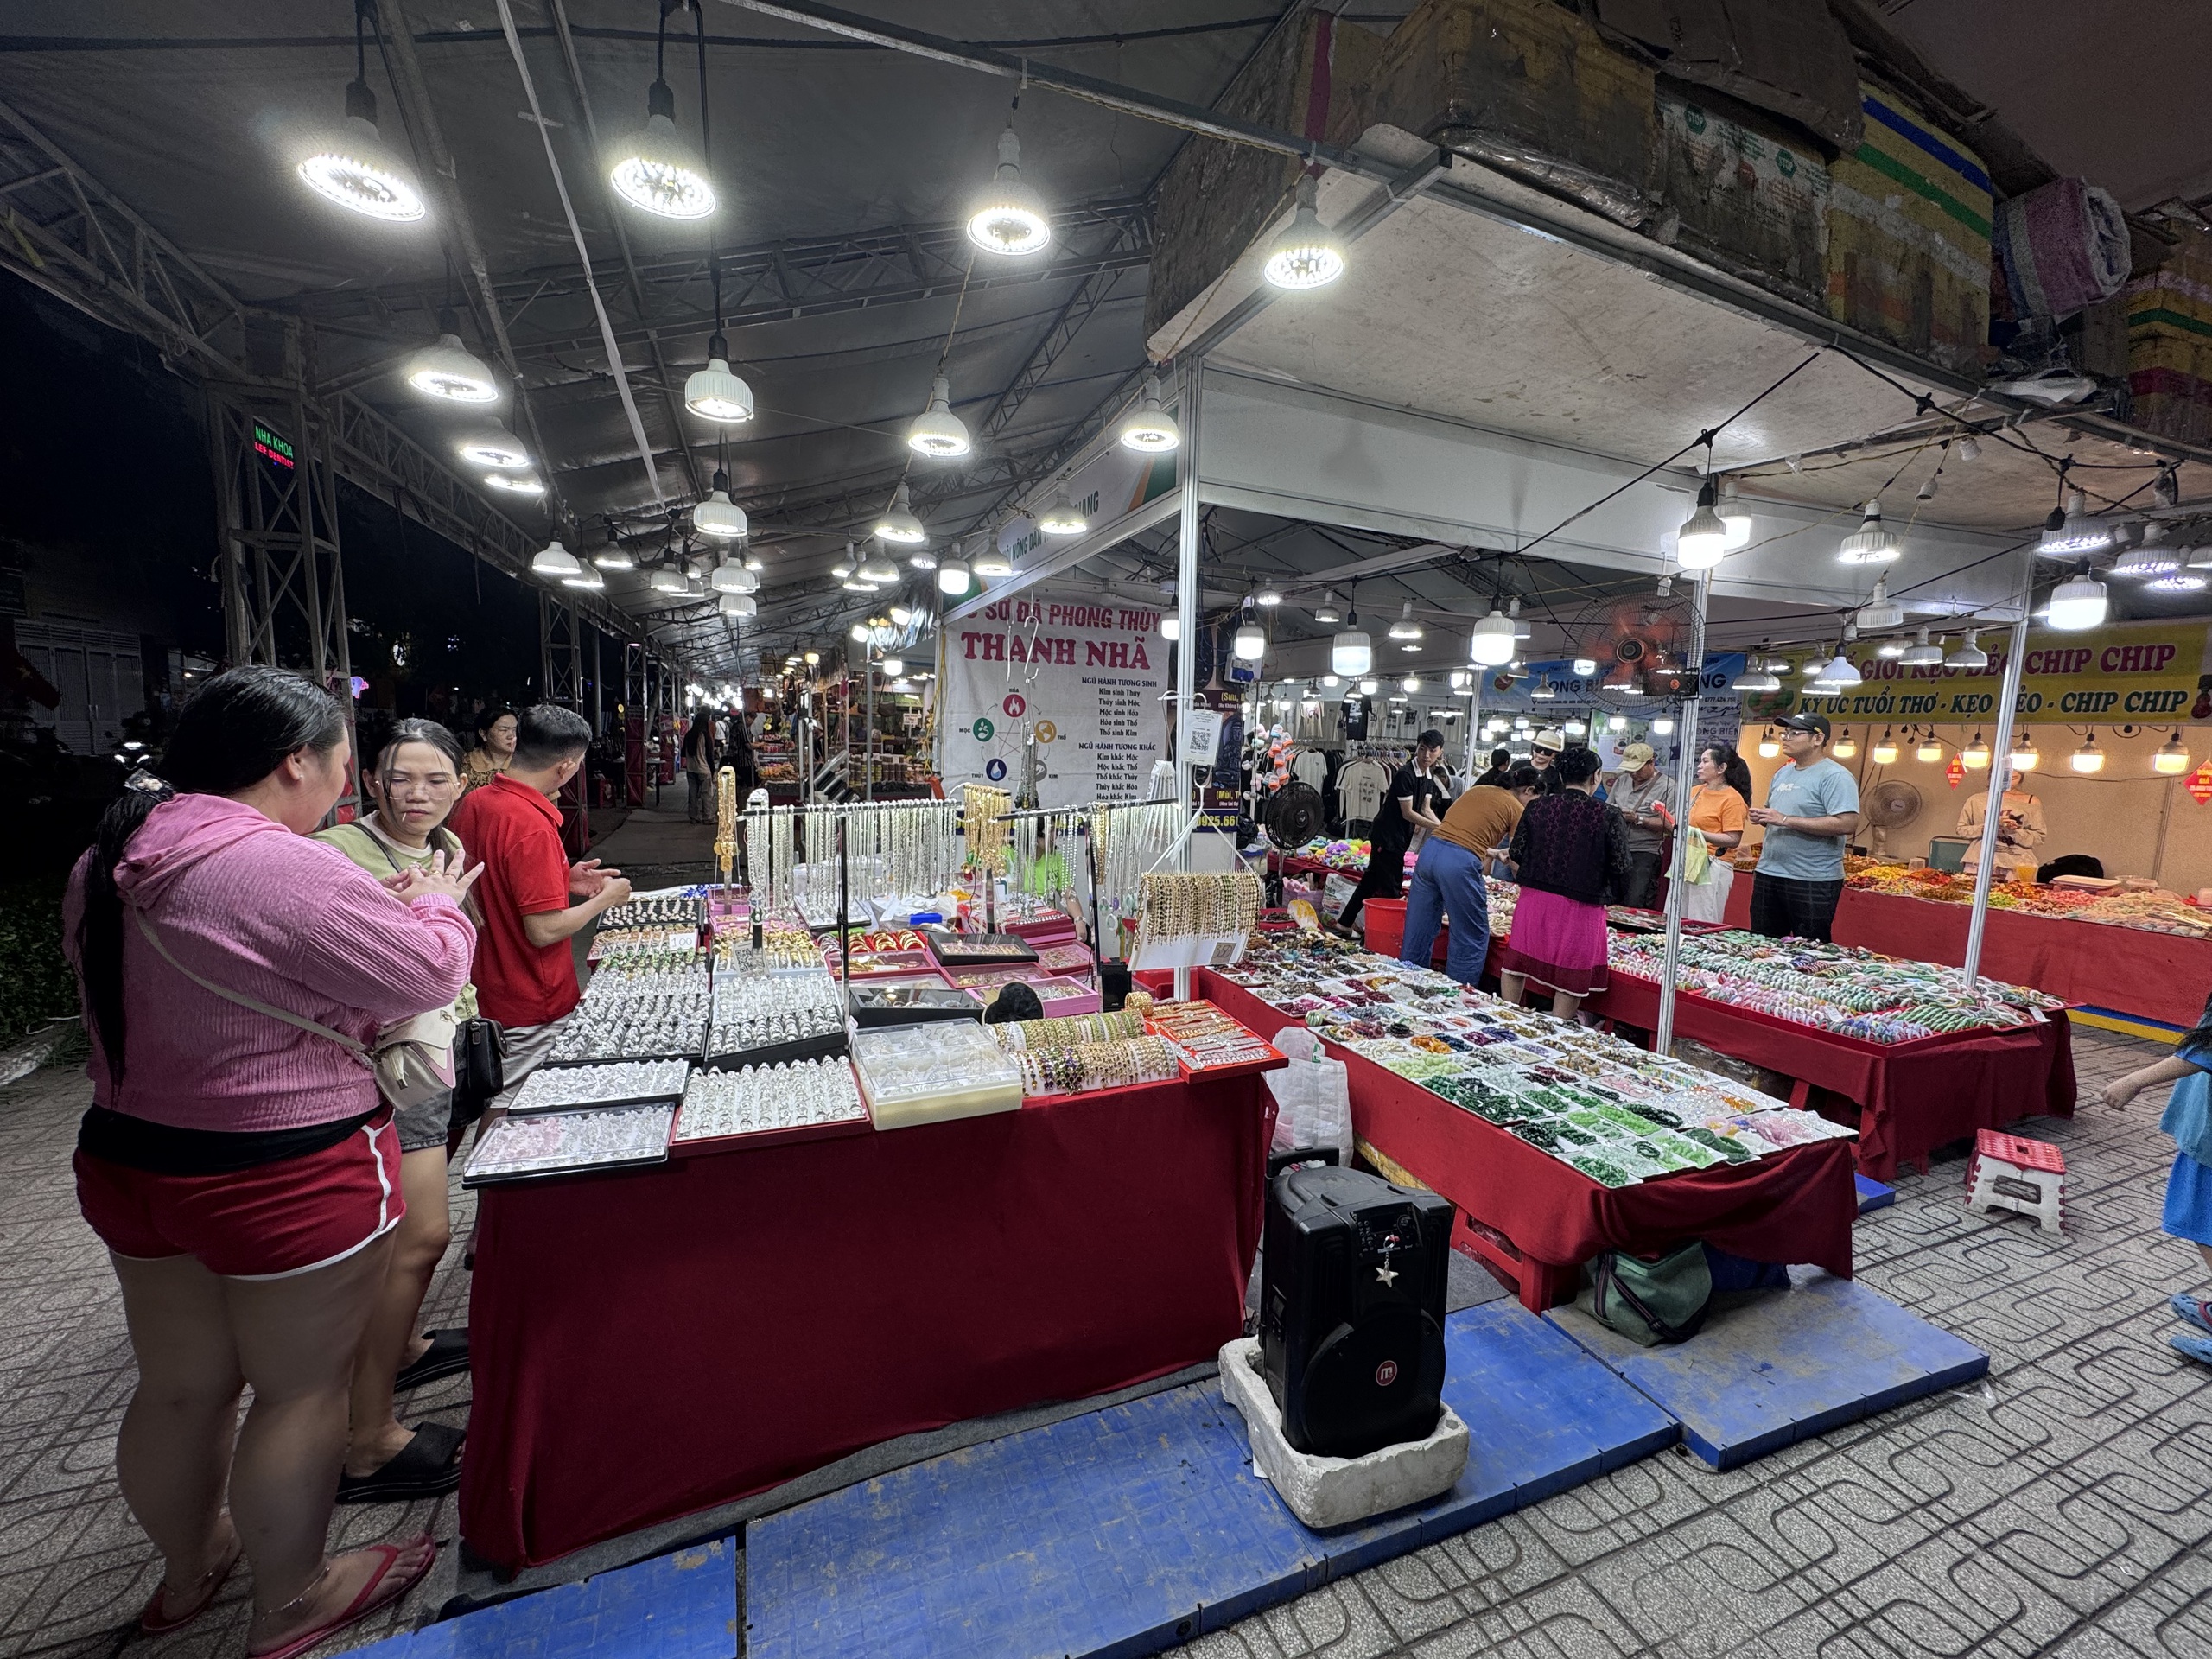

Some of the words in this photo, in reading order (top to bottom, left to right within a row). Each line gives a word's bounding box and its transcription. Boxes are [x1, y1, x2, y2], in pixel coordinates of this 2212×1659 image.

[255, 425, 272, 447] NHA
[273, 436, 294, 459] KHOA
[255, 442, 267, 454] LEE
[1049, 603, 1113, 630] PHONG
[1119, 606, 1161, 632] THỦY
[960, 631, 1077, 665] THANH
[1084, 635, 1151, 671] NHÃ
[2024, 648, 2093, 674] CHIP
[2100, 644, 2176, 673] CHIP
[1097, 677, 1116, 686] HÀNH
[1853, 685, 1896, 714] TUỔI
[1900, 692, 1939, 714] THƠ
[1950, 694, 1993, 718] KẸO
[2060, 691, 2119, 713] CHIP
[2124, 690, 2189, 713] CHIP
[1095, 741, 1113, 750] HÀNH
[671, 937, 692, 947] 100
